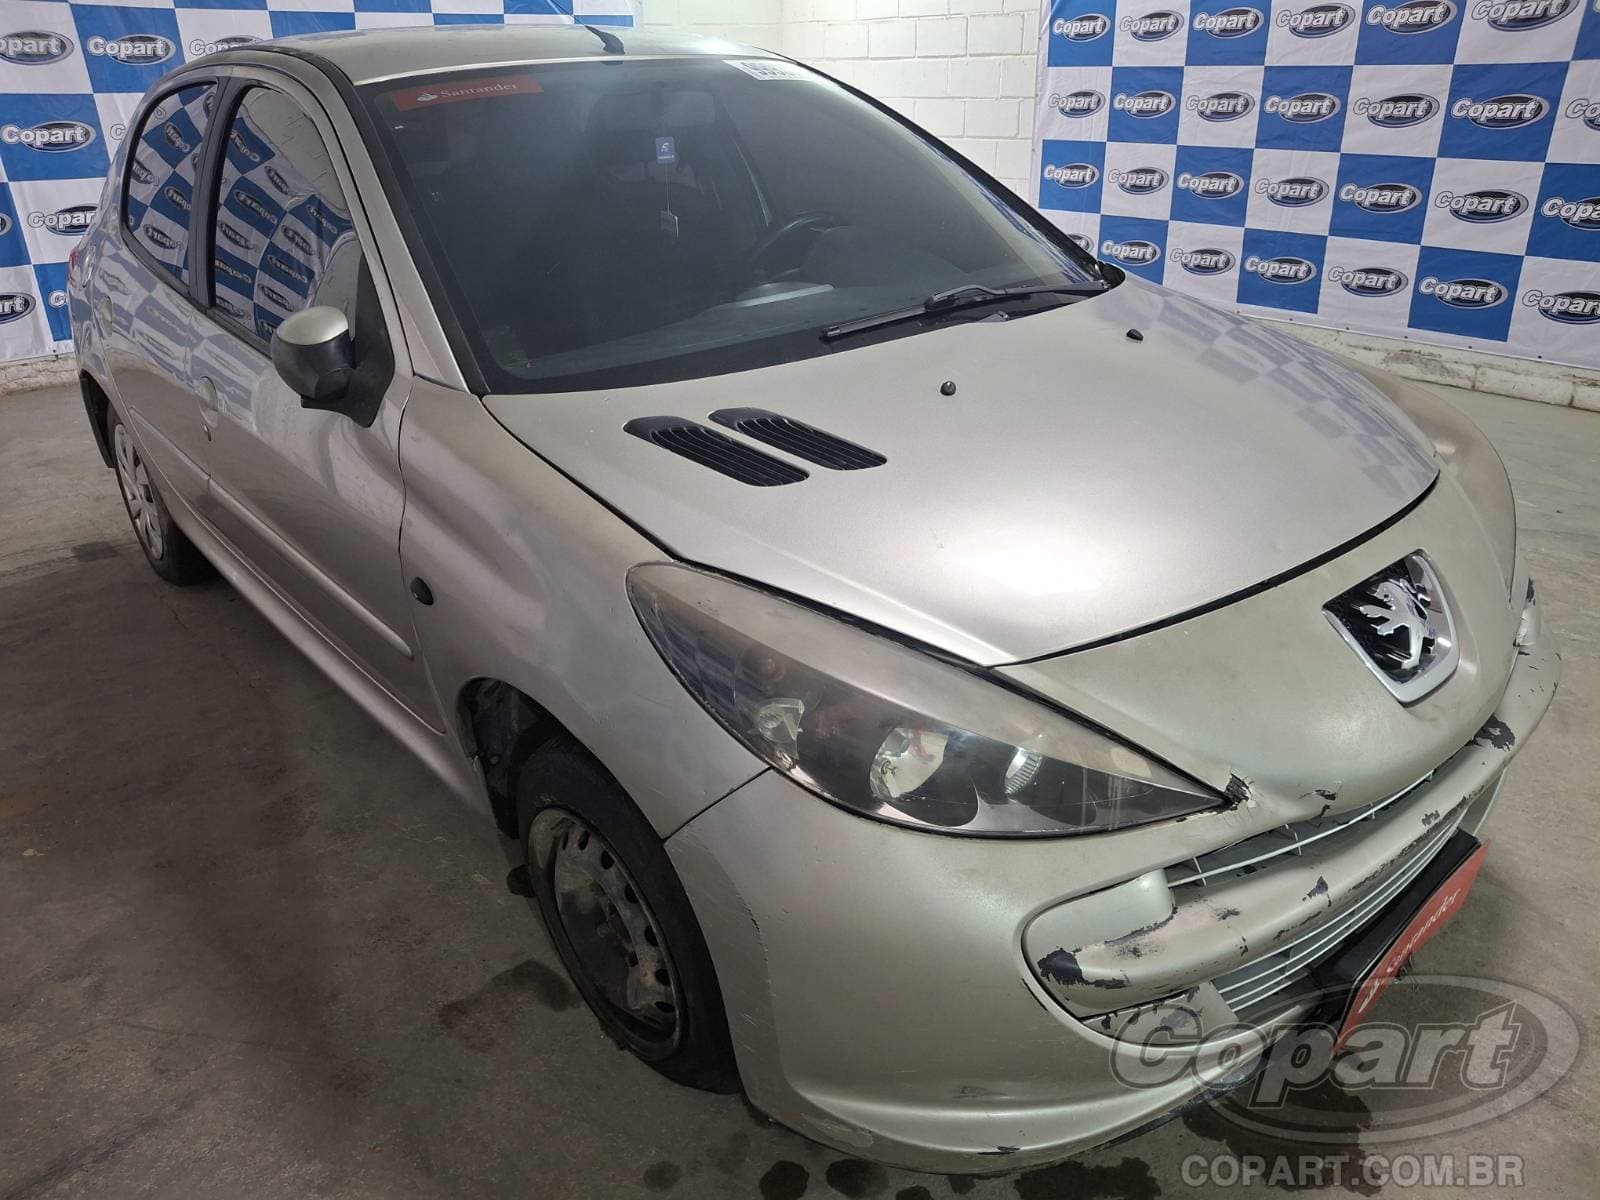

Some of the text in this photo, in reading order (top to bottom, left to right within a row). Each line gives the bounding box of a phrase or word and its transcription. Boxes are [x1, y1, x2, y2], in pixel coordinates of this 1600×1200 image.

[1193, 11, 1254, 31] Copart
[1276, 8, 1345, 28] Copart
[1366, 2, 1448, 28] Copart
[1472, 0, 1565, 25] Copart
[1052, 17, 1104, 35] Copart
[1120, 15, 1177, 33] Copart
[0, 36, 61, 56] opart
[88, 36, 166, 59] Copart
[440, 82, 518, 97] Santander
[1049, 93, 1099, 112] Copart
[1113, 93, 1169, 113] Copart
[1186, 95, 1245, 113] Copart
[1264, 95, 1332, 116] Copart
[1353, 97, 1428, 118] Copart
[1451, 98, 1537, 120] Copart
[1, 125, 86, 147] Copart
[1044, 163, 1093, 183] Copart
[1108, 168, 1163, 188] Copart
[1177, 172, 1236, 193] Copart
[1254, 178, 1320, 199] Copart
[1340, 184, 1416, 209] Copart
[1434, 191, 1518, 215] Copart
[1101, 239, 1155, 260] Copart
[1170, 247, 1227, 269] Copart
[1244, 255, 1309, 279] Copart
[1328, 265, 1400, 290] Copart
[1419, 276, 1499, 303] Copart
